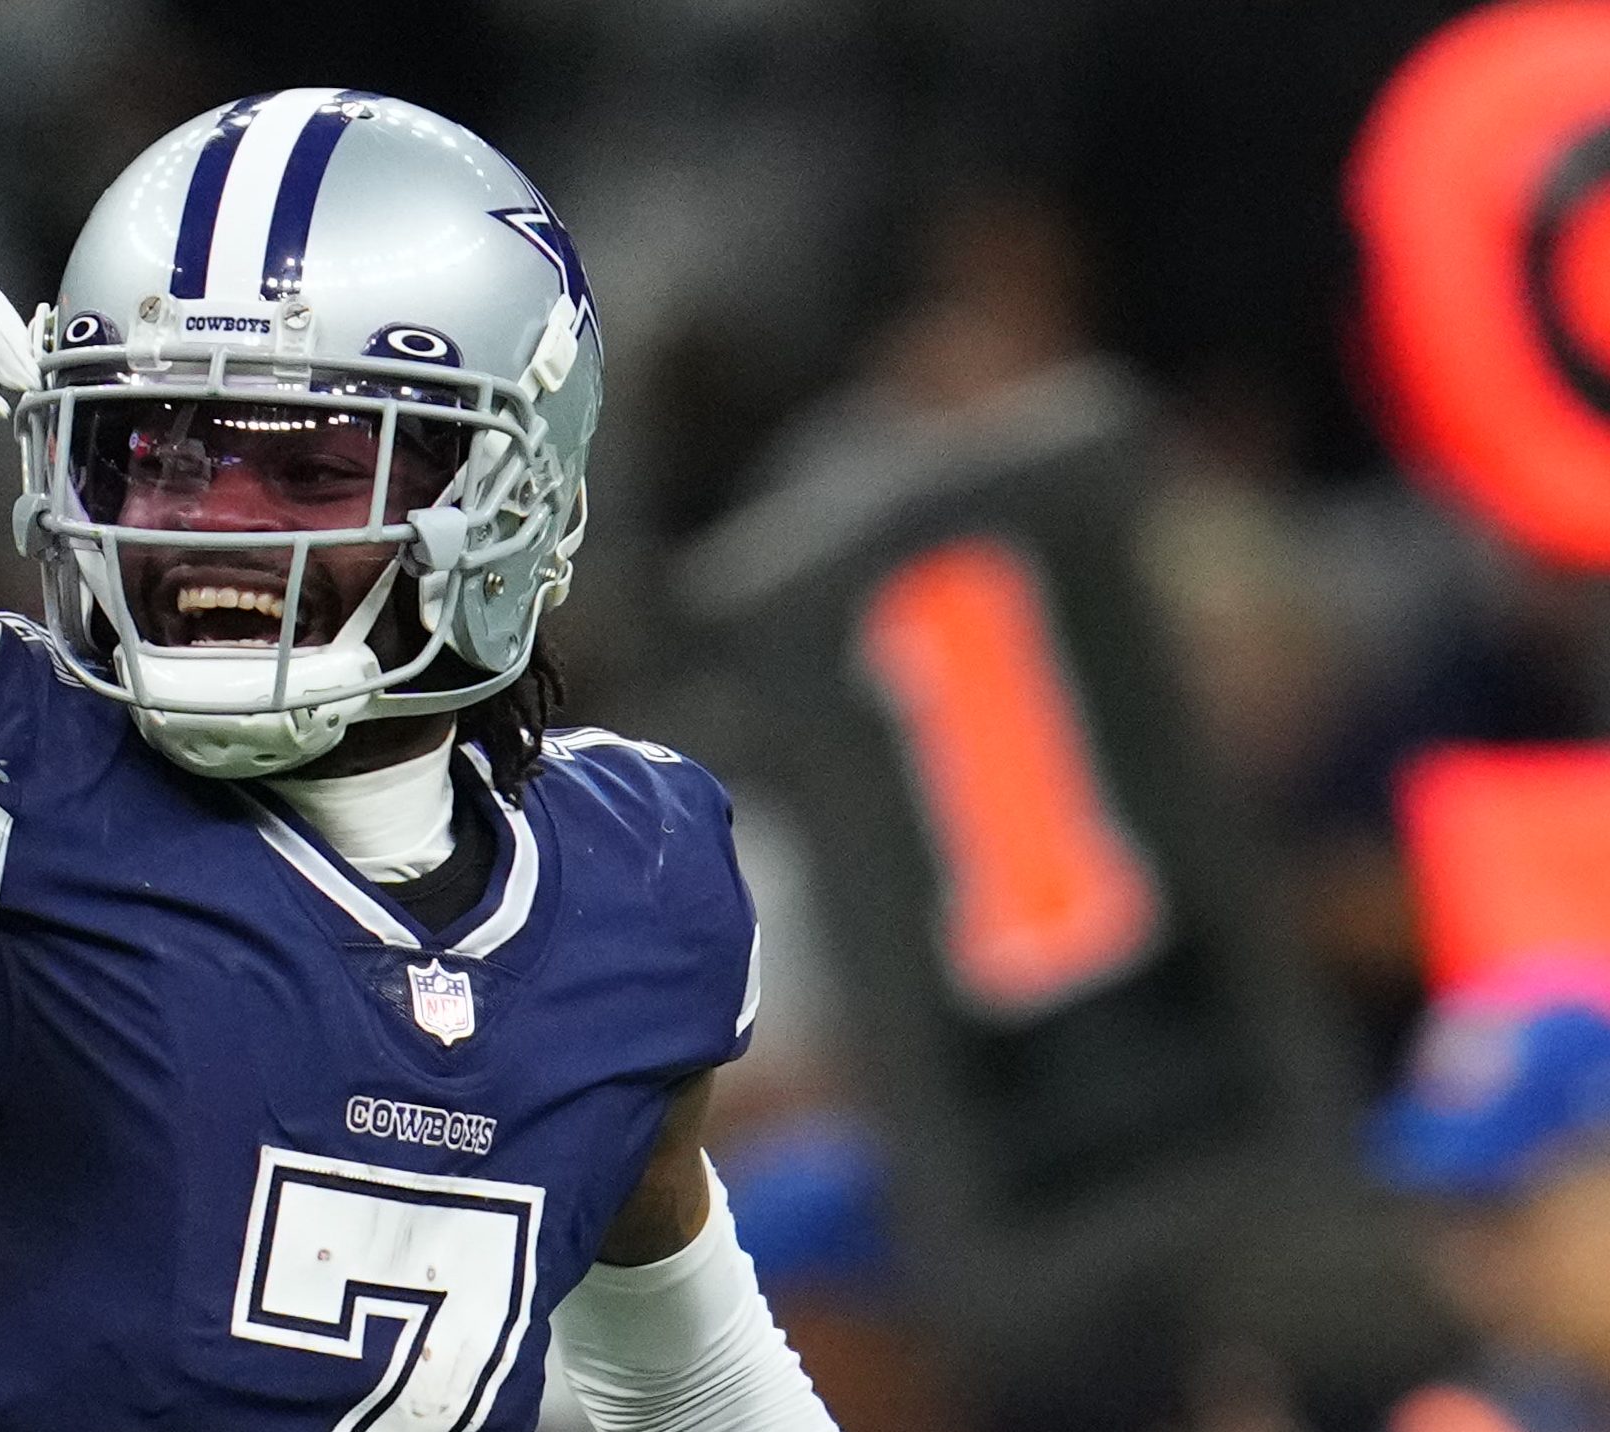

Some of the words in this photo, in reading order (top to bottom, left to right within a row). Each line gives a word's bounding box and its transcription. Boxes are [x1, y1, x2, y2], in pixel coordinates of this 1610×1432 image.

[185, 316, 271, 333] COWBOYS
[860, 530, 1163, 1005] 1
[425, 997, 466, 1026] NFL
[346, 1095, 497, 1155] COWBOYS
